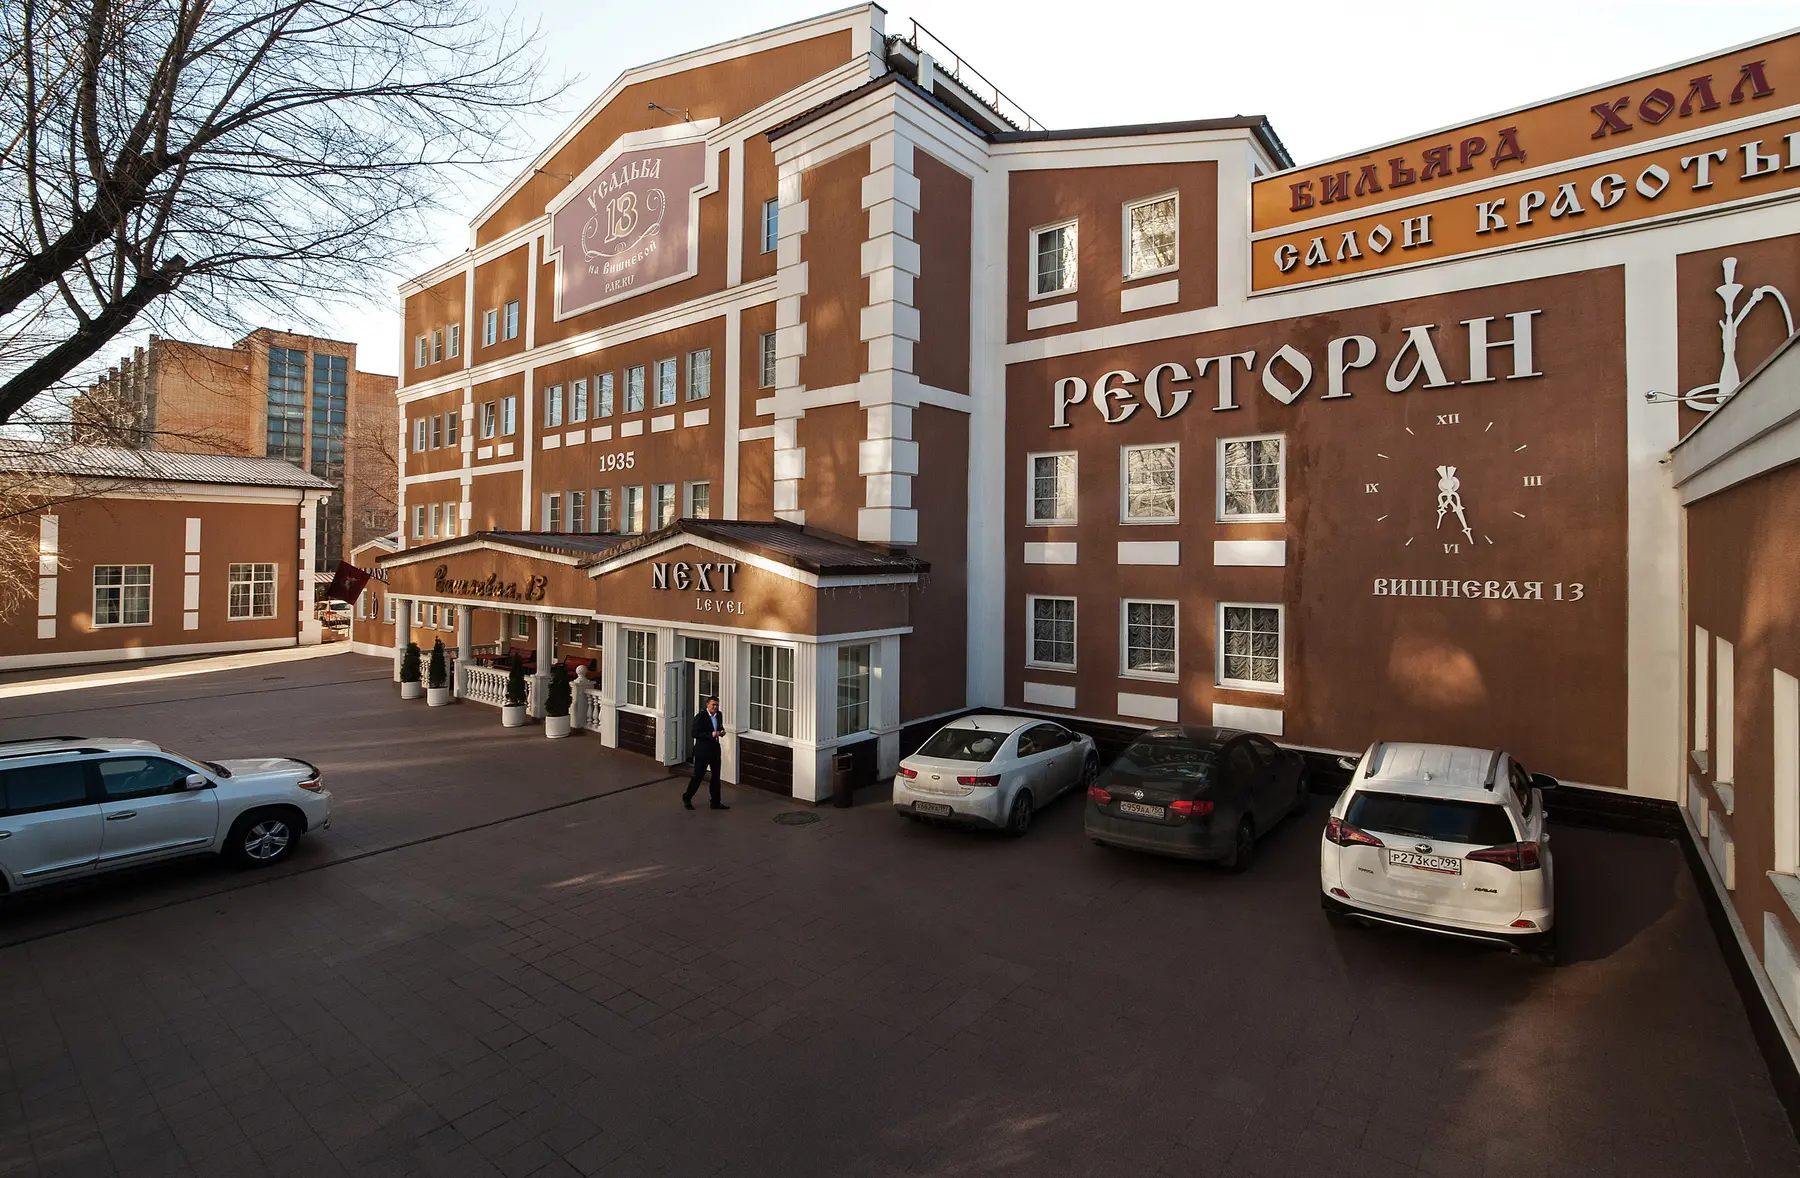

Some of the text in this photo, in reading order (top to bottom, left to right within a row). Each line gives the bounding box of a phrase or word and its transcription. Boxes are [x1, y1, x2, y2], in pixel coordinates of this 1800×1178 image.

[1289, 59, 1776, 212] БИЛЬЯРД ХОЛЛ
[587, 158, 661, 212] УСАДЬБА
[1273, 131, 1800, 273] САЛОН КРАСОТЫ
[604, 191, 639, 244] 13
[1049, 309, 1543, 429] РЕСТОРАН
[1436, 413, 1460, 426] XII
[599, 451, 635, 472] 1935
[1365, 482, 1379, 494] IX
[1523, 475, 1543, 487] III
[1443, 543, 1460, 554] VI
[525, 575, 548, 600] 13
[651, 562, 737, 592] NEXT
[1372, 577, 1585, 602] ВИШНЕВАЯ 13
[696, 598, 745, 615] LEVEL
